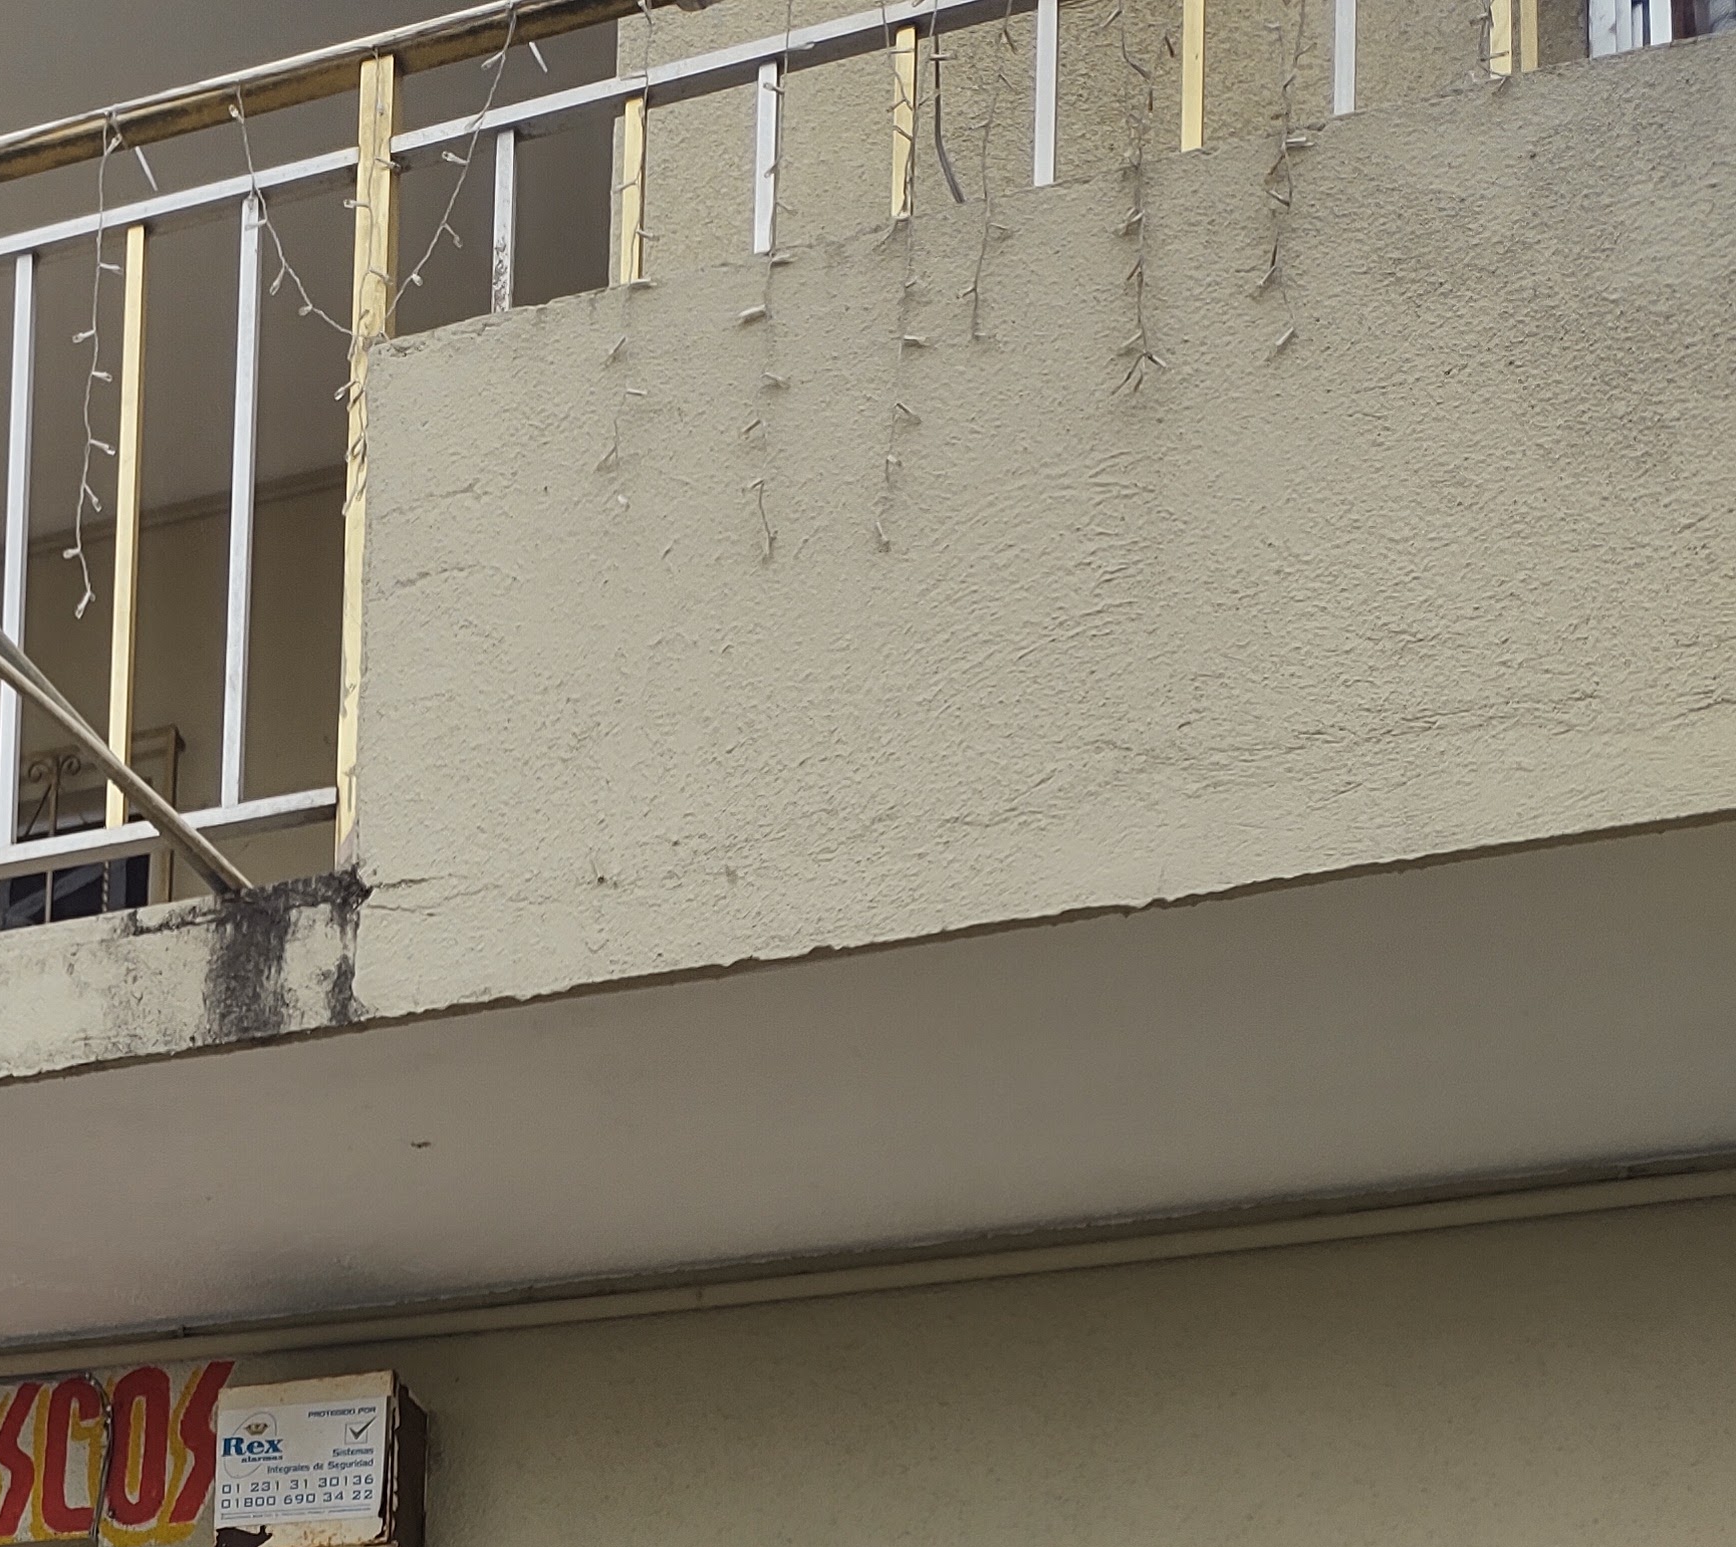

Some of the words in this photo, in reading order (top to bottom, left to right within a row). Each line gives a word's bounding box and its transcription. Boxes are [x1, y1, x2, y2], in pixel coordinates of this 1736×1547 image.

[357, 1406, 377, 1415] POR
[221, 1436, 284, 1457] Rex
[332, 1447, 374, 1458] Sistemas
[241, 1454, 284, 1464] alarmas
[267, 1463, 310, 1475] Integrales
[313, 1462, 325, 1471] de
[327, 1458, 374, 1471] Seguridad
[221, 1483, 240, 1495] 01
[250, 1482, 280, 1493] 231
[290, 1479, 308, 1490] 31
[318, 1474, 374, 1488] 30136
[221, 1495, 276, 1509] 01800
[283, 1493, 316, 1505] 690
[322, 1490, 345, 1503] 34
[352, 1489, 373, 1500] 22
